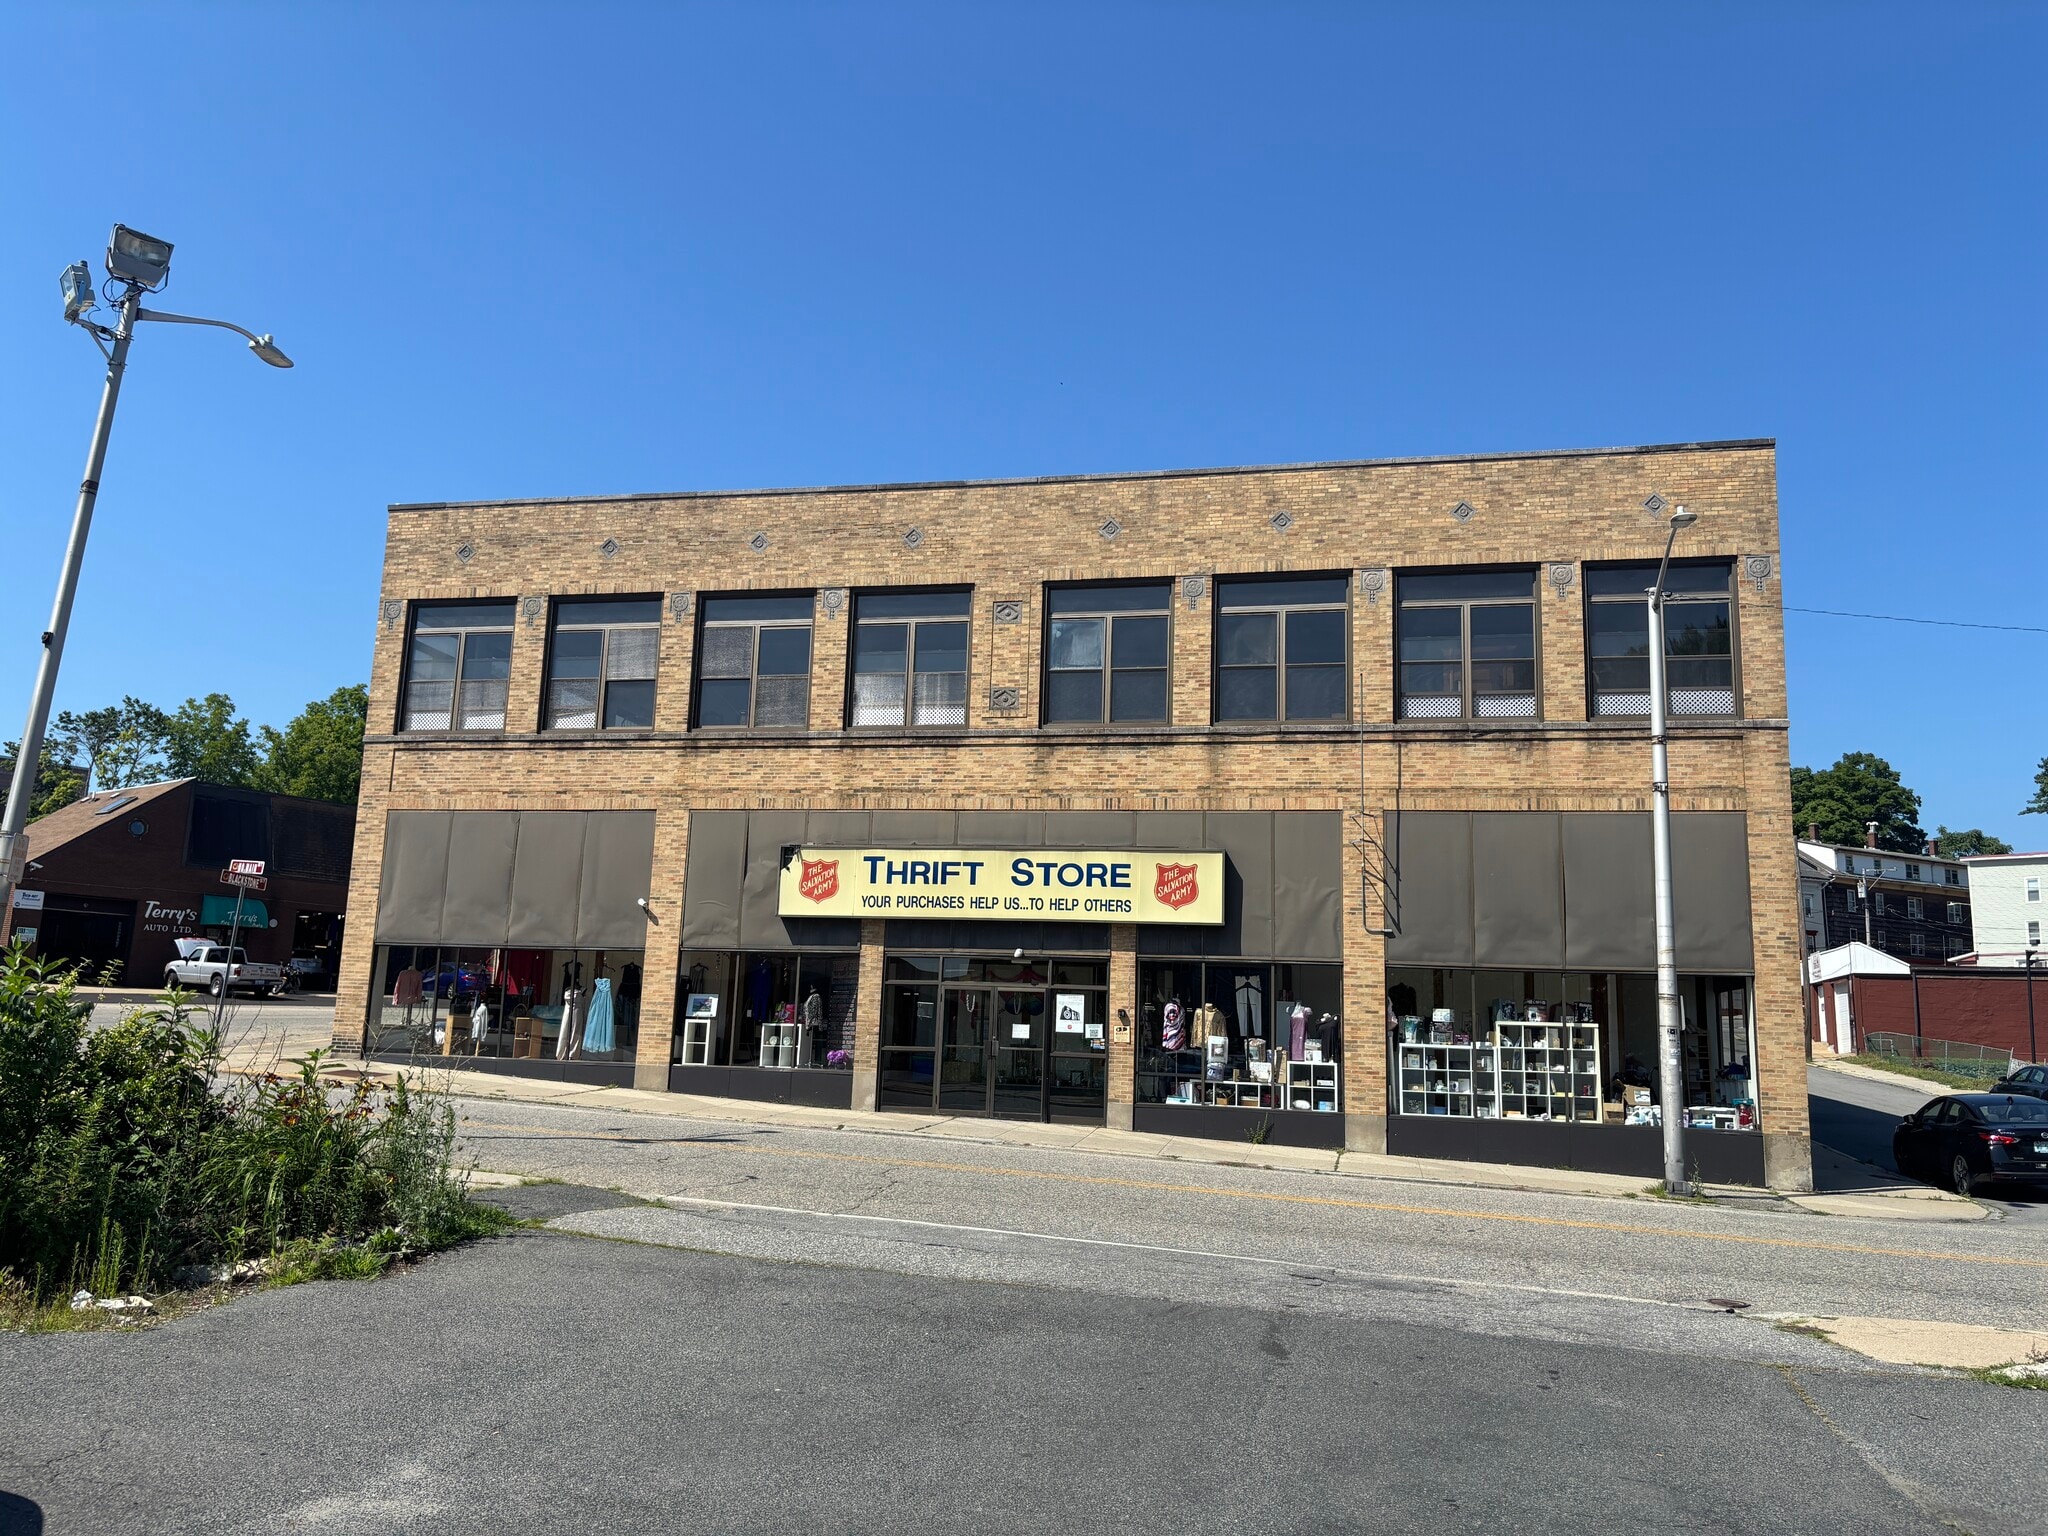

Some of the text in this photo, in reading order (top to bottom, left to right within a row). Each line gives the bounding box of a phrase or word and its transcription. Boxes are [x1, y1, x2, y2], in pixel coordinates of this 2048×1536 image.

[801, 866, 836, 892] SALVATION
[807, 864, 823, 876] THE
[863, 856, 1132, 888] THRIFT STORE
[1163, 867, 1181, 882] THE
[812, 879, 835, 898] ARMY
[1157, 870, 1194, 897] SALVATION
[1170, 882, 1193, 902] ARMY
[144, 900, 198, 925] Terry's
[861, 895, 891, 909] YOUR
[896, 895, 965, 909] PURCHASES
[970, 896, 999, 910] HELP
[1049, 898, 1079, 911] HELP
[1084, 898, 1132, 912] OTHERS
[143, 924, 169, 932] AUTO
